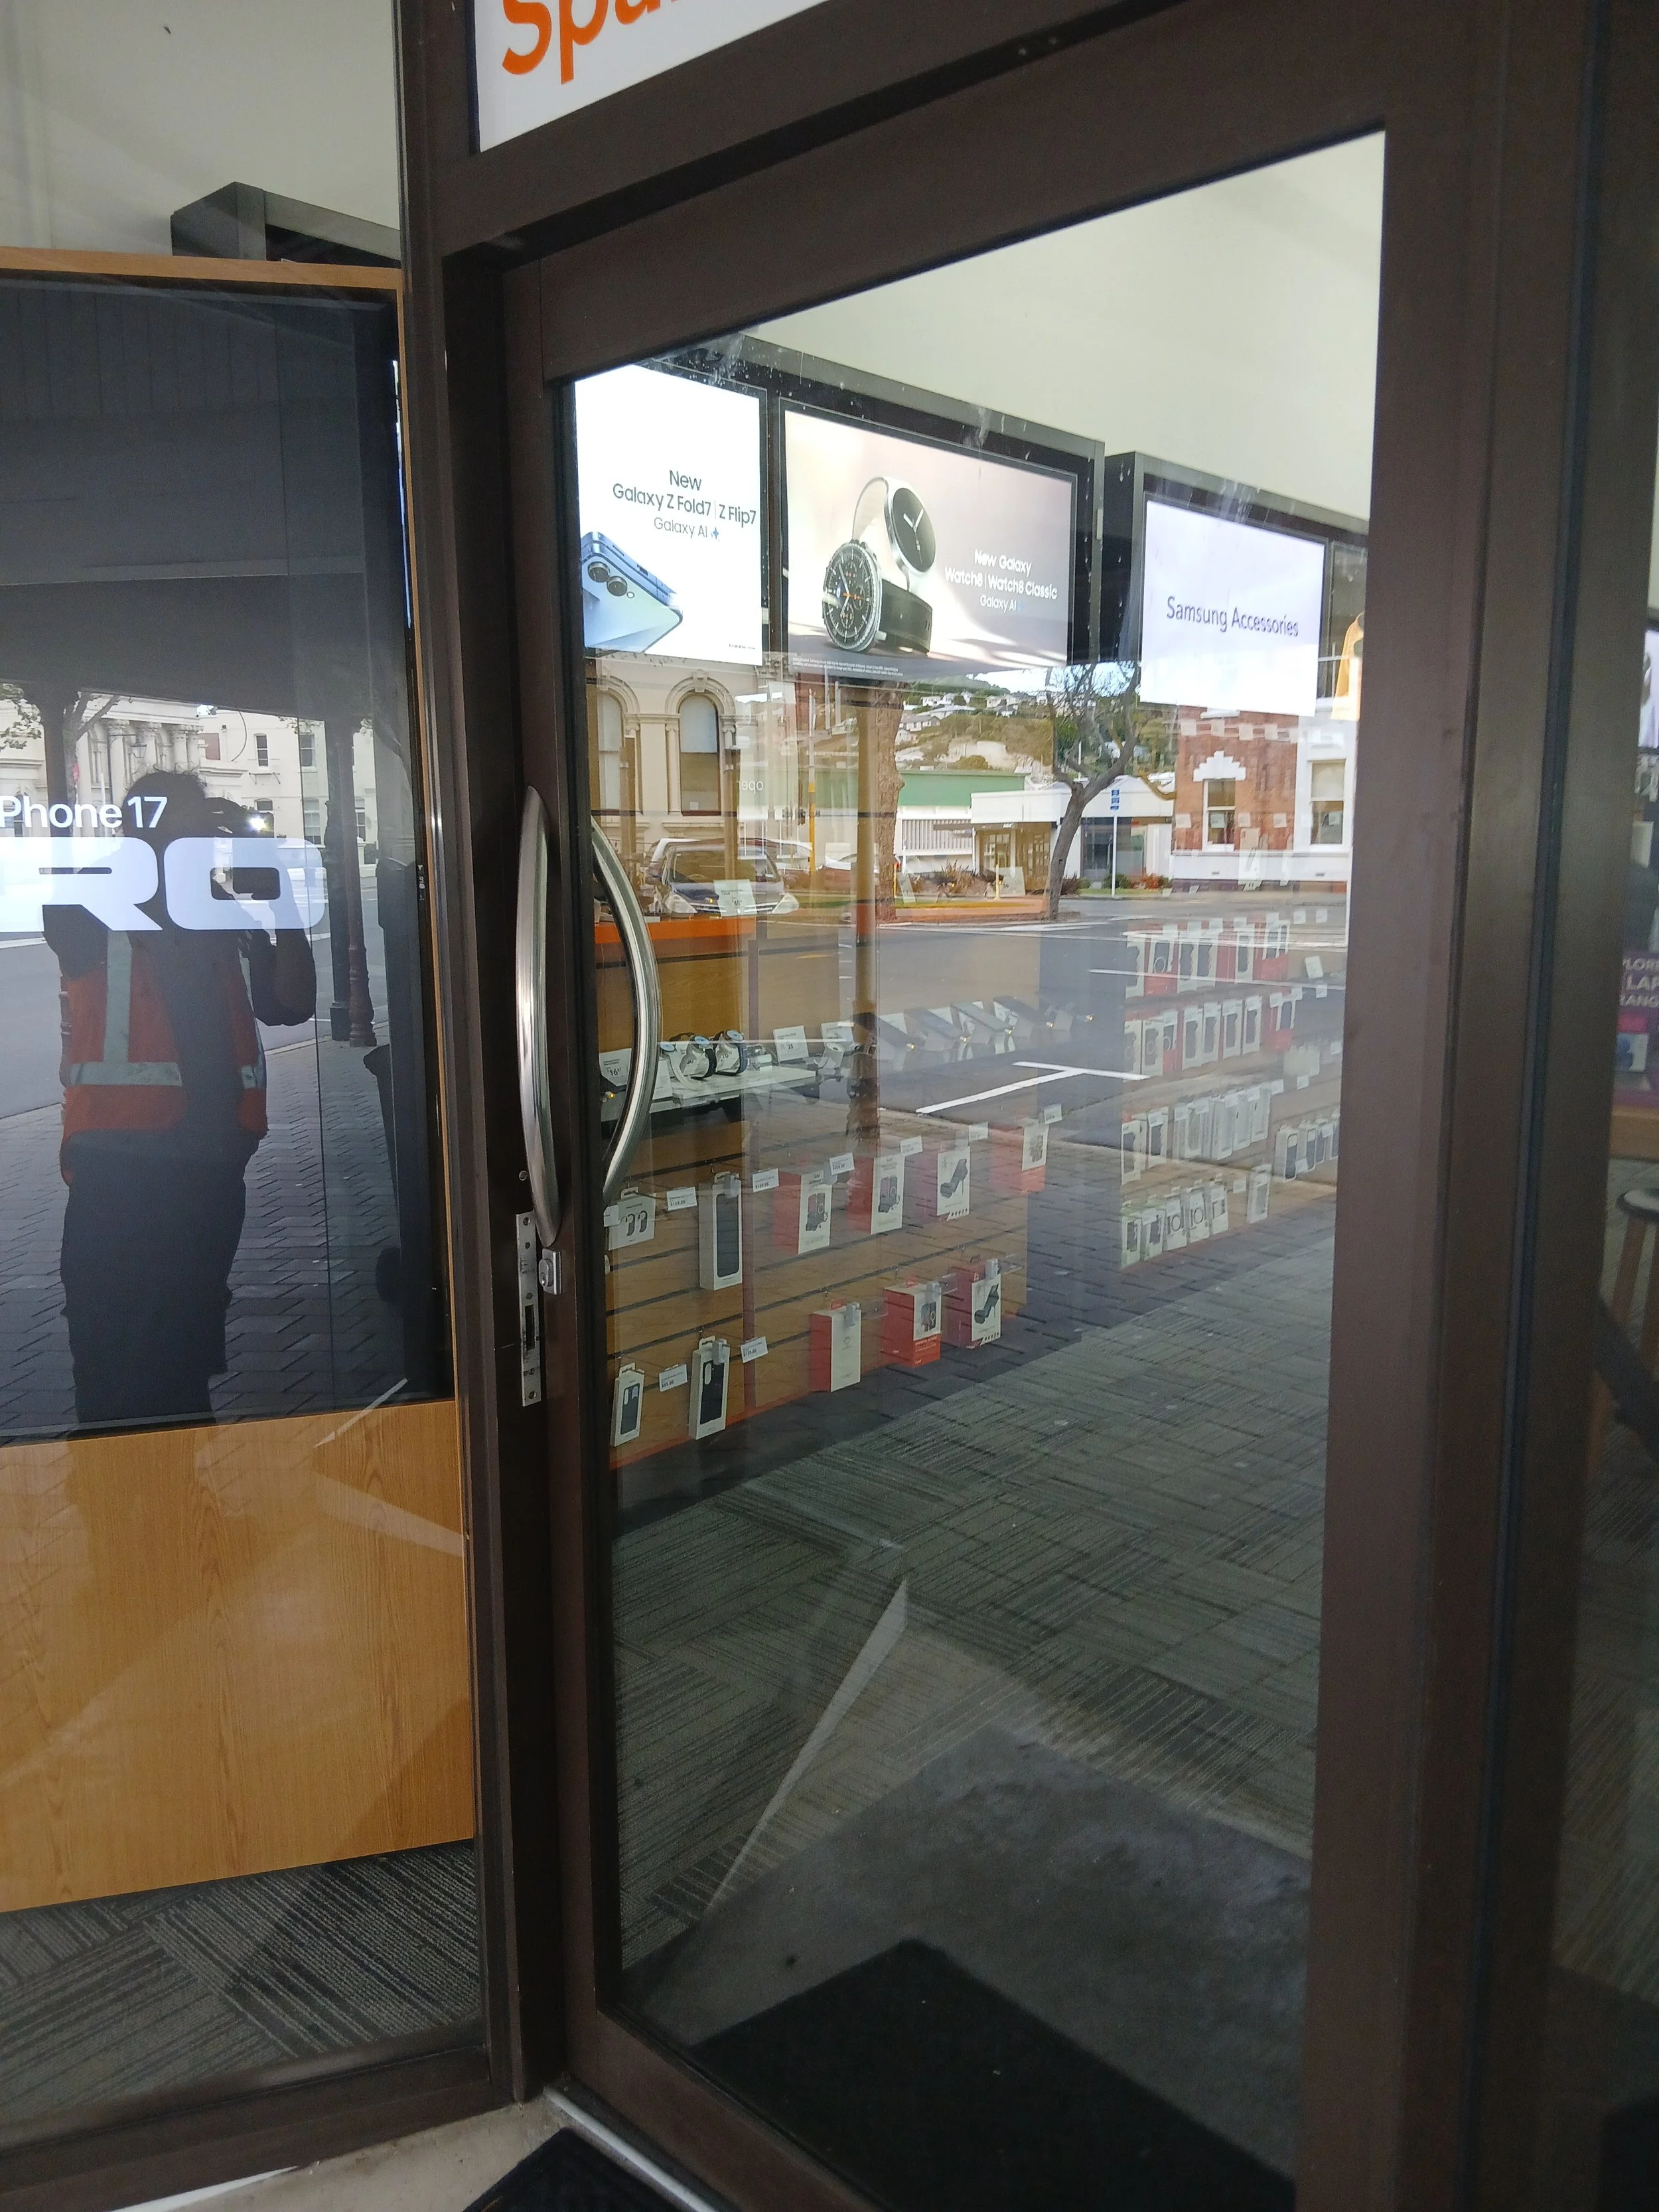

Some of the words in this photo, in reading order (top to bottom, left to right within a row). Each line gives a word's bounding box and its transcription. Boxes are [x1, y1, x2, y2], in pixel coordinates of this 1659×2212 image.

[502, 0, 678, 85] Sp
[669, 469, 702, 491] New
[613, 483, 664, 511] Galaxy
[666, 493, 674, 509] Z
[678, 496, 711, 516] Fold7
[719, 504, 726, 520] Z
[729, 506, 757, 528] Flip7
[654, 516, 695, 539] Galaxy
[697, 525, 708, 538] AI
[974, 550, 997, 568] New
[999, 555, 1032, 577] Galaxy
[945, 567, 983, 587] Watch8
[988, 573, 1024, 594] Watch8
[1026, 581, 1058, 600] Classic
[980, 594, 1008, 613] Galaxy
[1009, 599, 1017, 611] AI
[1167, 595, 1228, 632] Samsung
[1232, 606, 1299, 637] Accessories
[0, 795, 123, 828] Phone
[127, 796, 168, 828] 17
